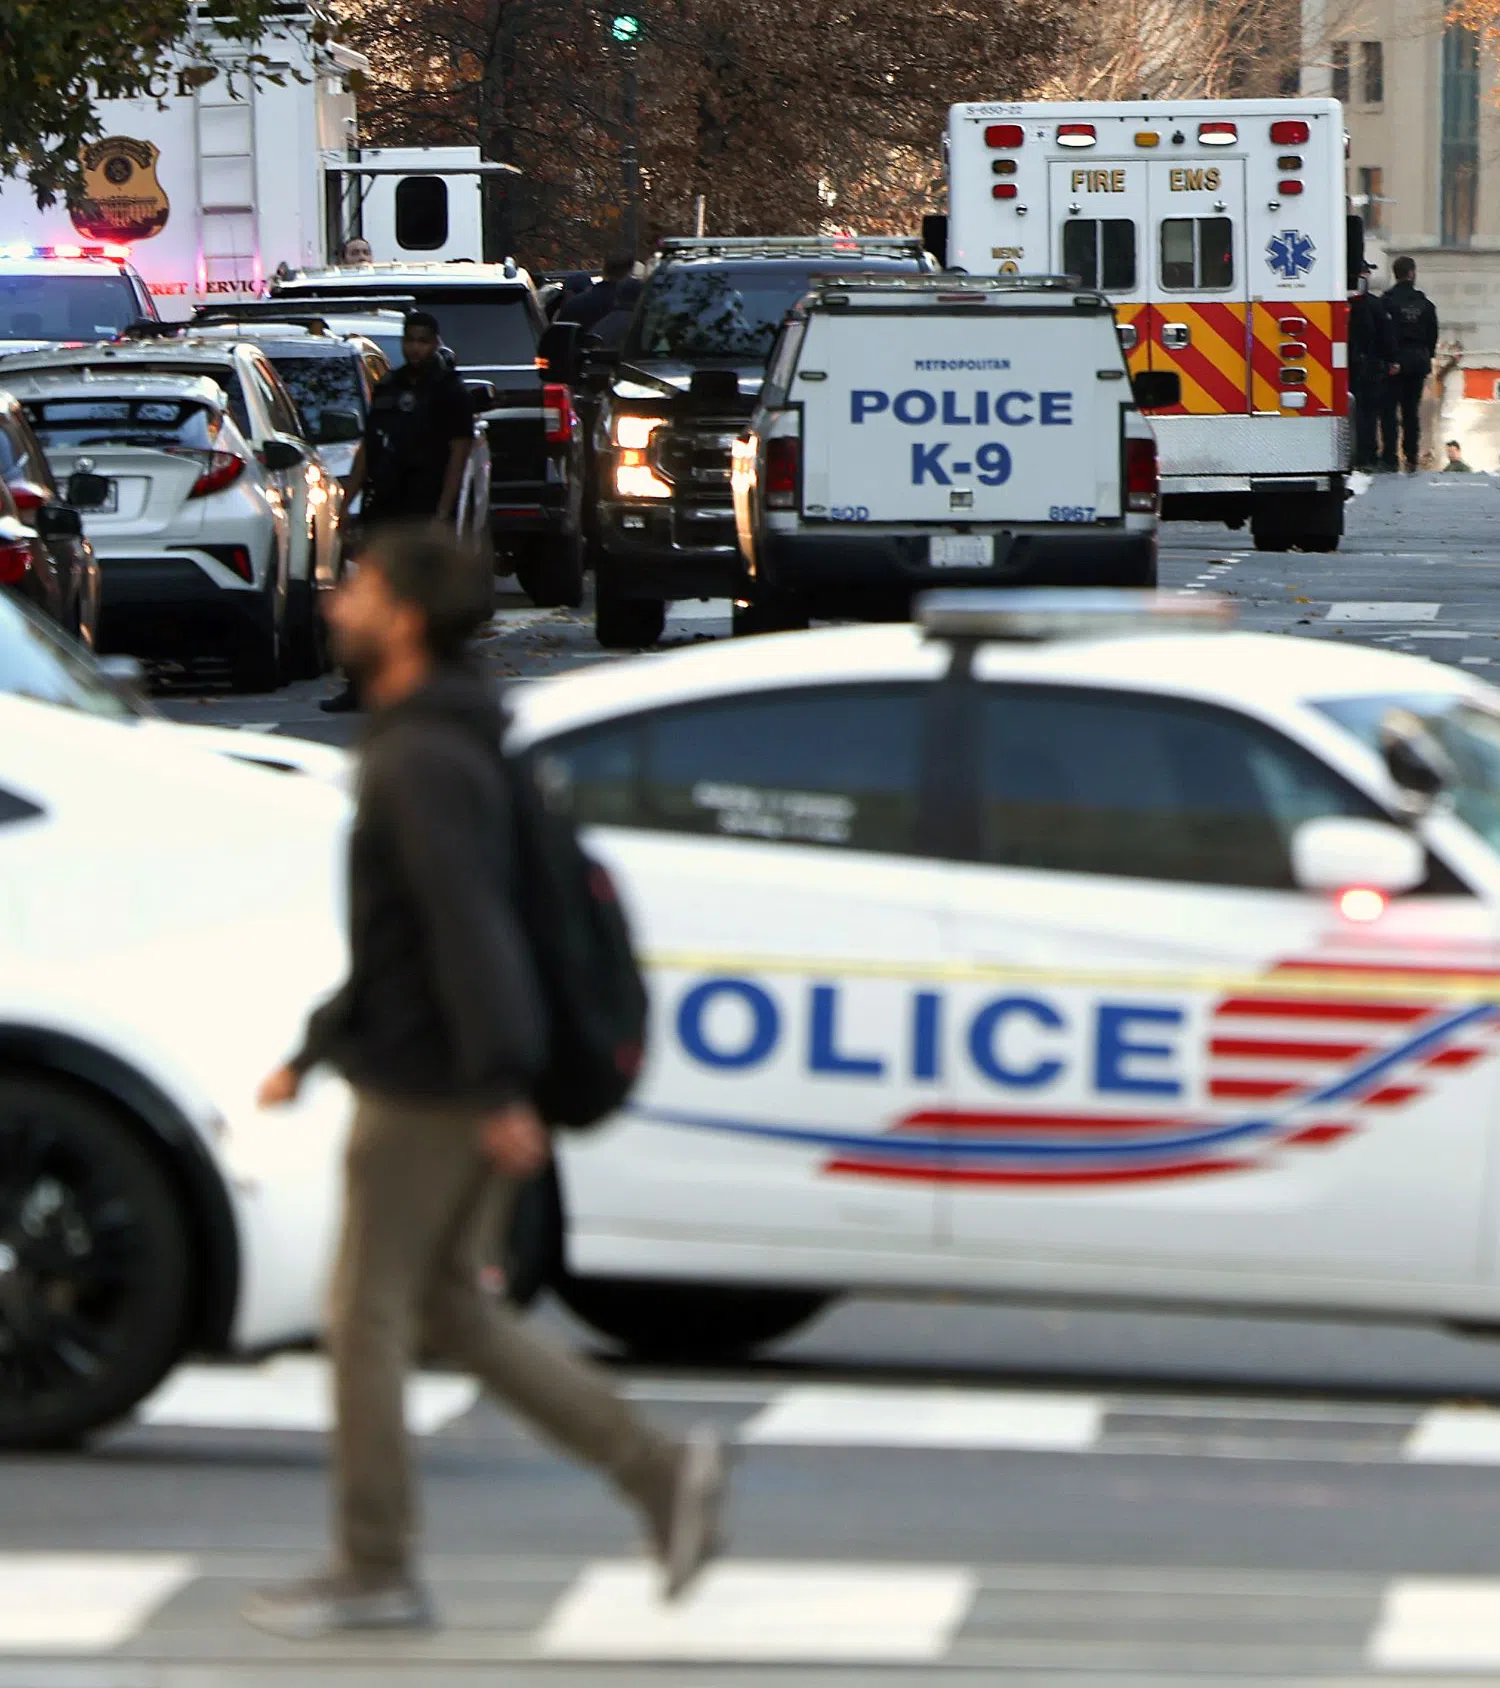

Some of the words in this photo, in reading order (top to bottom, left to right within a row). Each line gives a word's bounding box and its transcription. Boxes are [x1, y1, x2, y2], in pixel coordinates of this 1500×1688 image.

[1071, 169, 1126, 193] FIRE
[1169, 167, 1222, 192] EMS
[914, 359, 1012, 371] METROPOLITAN
[850, 389, 1073, 426] POLICE
[911, 441, 1013, 486] K-9
[675, 977, 1186, 1096] OLICE
